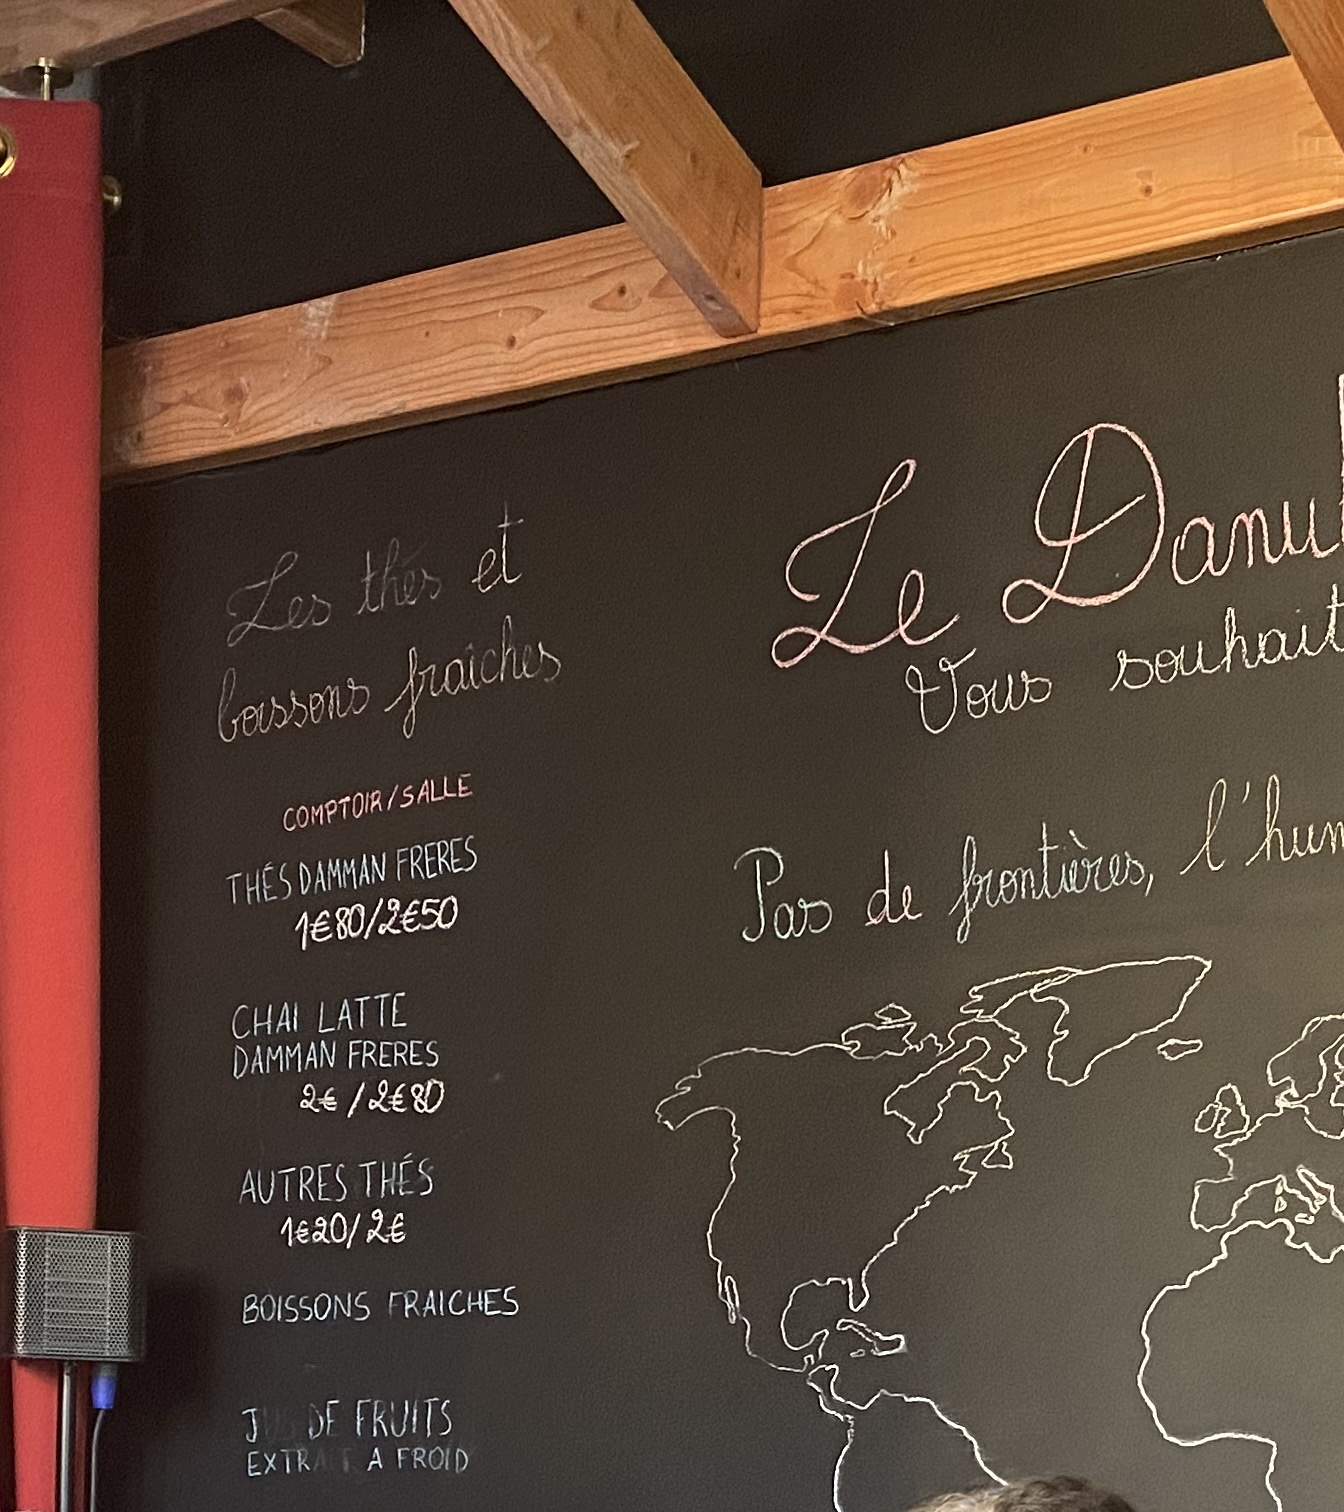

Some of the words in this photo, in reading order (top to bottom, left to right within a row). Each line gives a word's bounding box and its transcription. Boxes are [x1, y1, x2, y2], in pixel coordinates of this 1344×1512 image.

[227, 552, 331, 648] Les
[358, 536, 444, 614] thés
[472, 500, 523, 593] et
[771, 459, 961, 668] Le
[217, 667, 370, 743] boissons
[905, 649, 1052, 734] Vous
[226, 862, 291, 905] THÉS
[299, 852, 387, 896] DAMMAN
[396, 835, 478, 882] FRERES
[733, 847, 834, 943] Pas
[864, 850, 923, 927] de
[949, 822, 1156, 944] frontières,
[232, 1003, 299, 1040] CHAI
[318, 992, 407, 1033] LATTE
[233, 1040, 336, 1079] DAMMAN
[348, 1039, 440, 1070] FRERES
[239, 1163, 348, 1205] AUTRES
[358, 1152, 436, 1199] THÉS
[242, 1290, 370, 1324] BOISSONS
[388, 1285, 520, 1317] FRAICHES
[309, 1399, 339, 1440] DE
[355, 1397, 453, 1440] FRUITS
[367, 1446, 384, 1473] A
[397, 1446, 471, 1475] FROID
